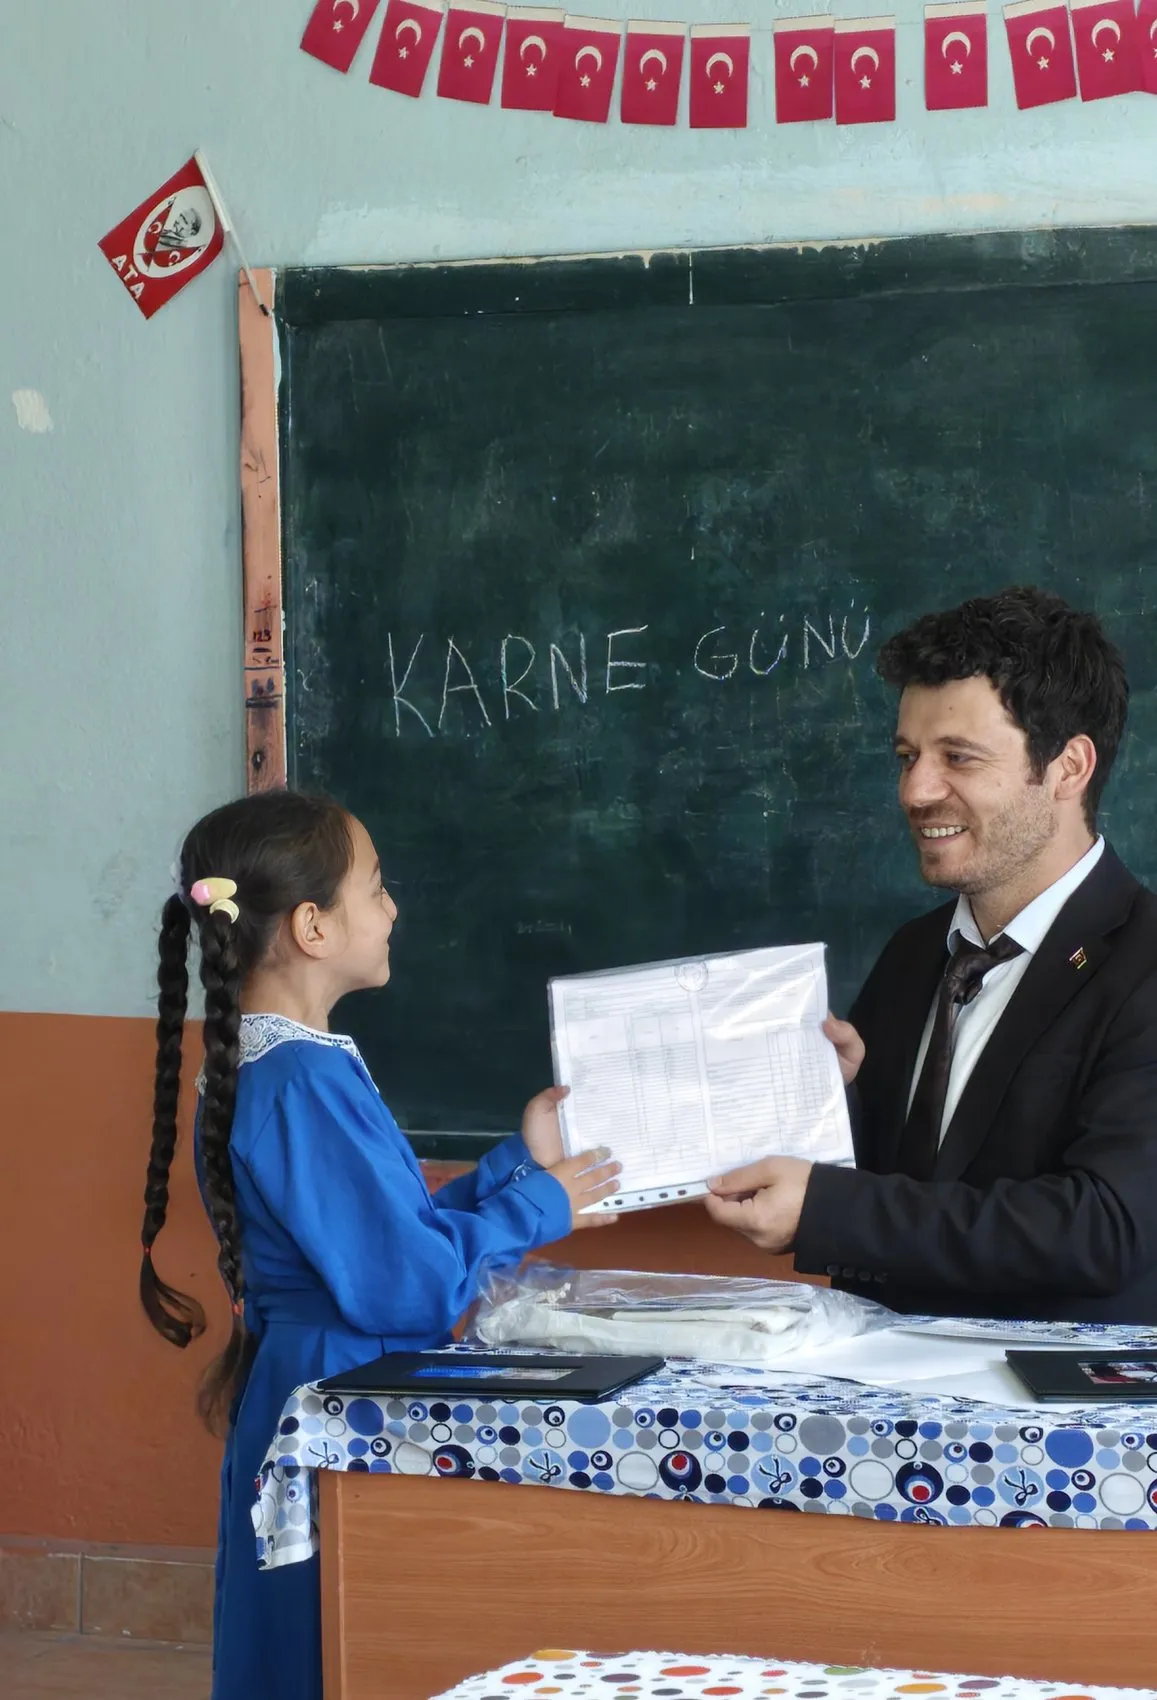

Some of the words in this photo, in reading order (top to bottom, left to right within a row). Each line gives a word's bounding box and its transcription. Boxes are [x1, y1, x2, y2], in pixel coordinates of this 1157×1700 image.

[112, 254, 145, 300] ATA
[388, 624, 649, 738] KARNE
[694, 598, 871, 681] GÜNÜ
